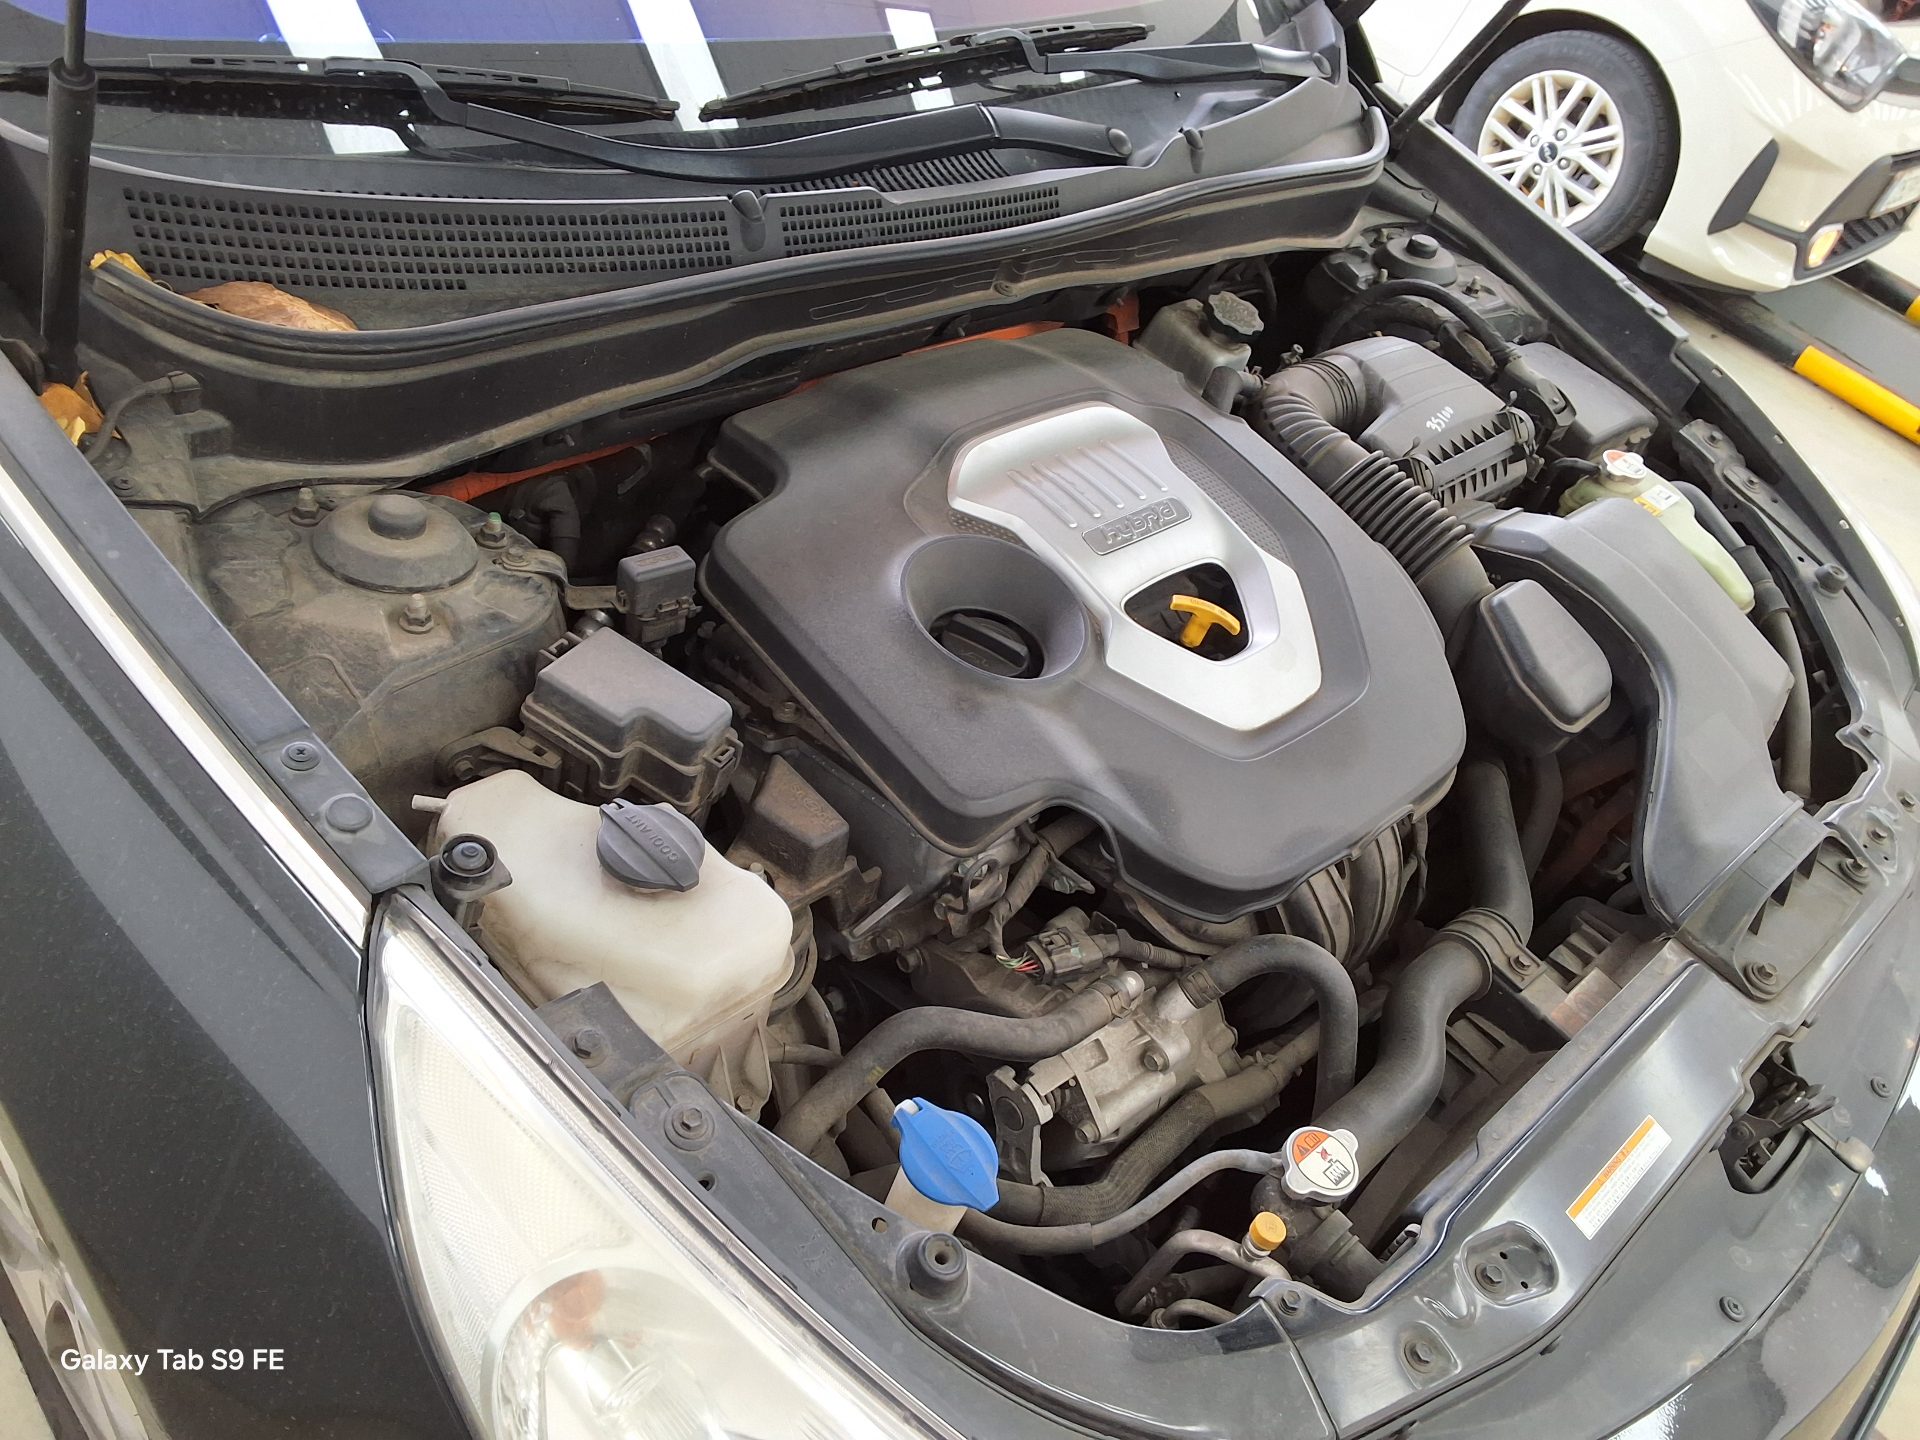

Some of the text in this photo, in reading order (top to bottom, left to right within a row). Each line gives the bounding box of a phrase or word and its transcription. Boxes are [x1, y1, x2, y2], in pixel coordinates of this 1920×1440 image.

[1426, 406, 1453, 432] 35100
[1100, 500, 1177, 545] hybrid
[624, 814, 680, 864] COOLANT
